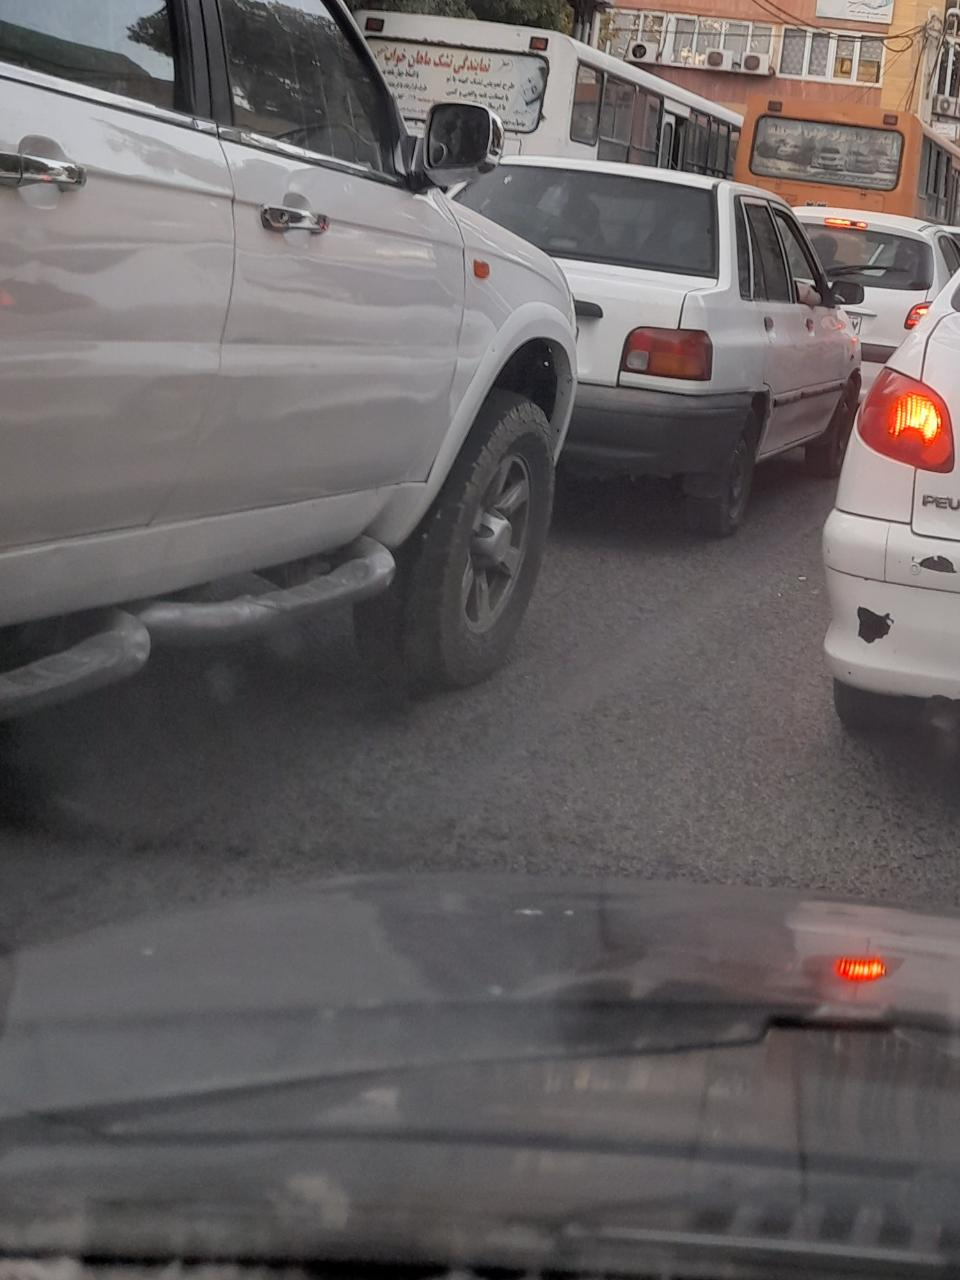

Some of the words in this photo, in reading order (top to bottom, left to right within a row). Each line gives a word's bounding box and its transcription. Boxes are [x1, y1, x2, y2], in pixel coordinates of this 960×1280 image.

[384, 47, 406, 67] خواب
[408, 50, 431, 68] ماهان
[433, 53, 454, 68] تشک
[453, 54, 491, 75] نمایندگی
